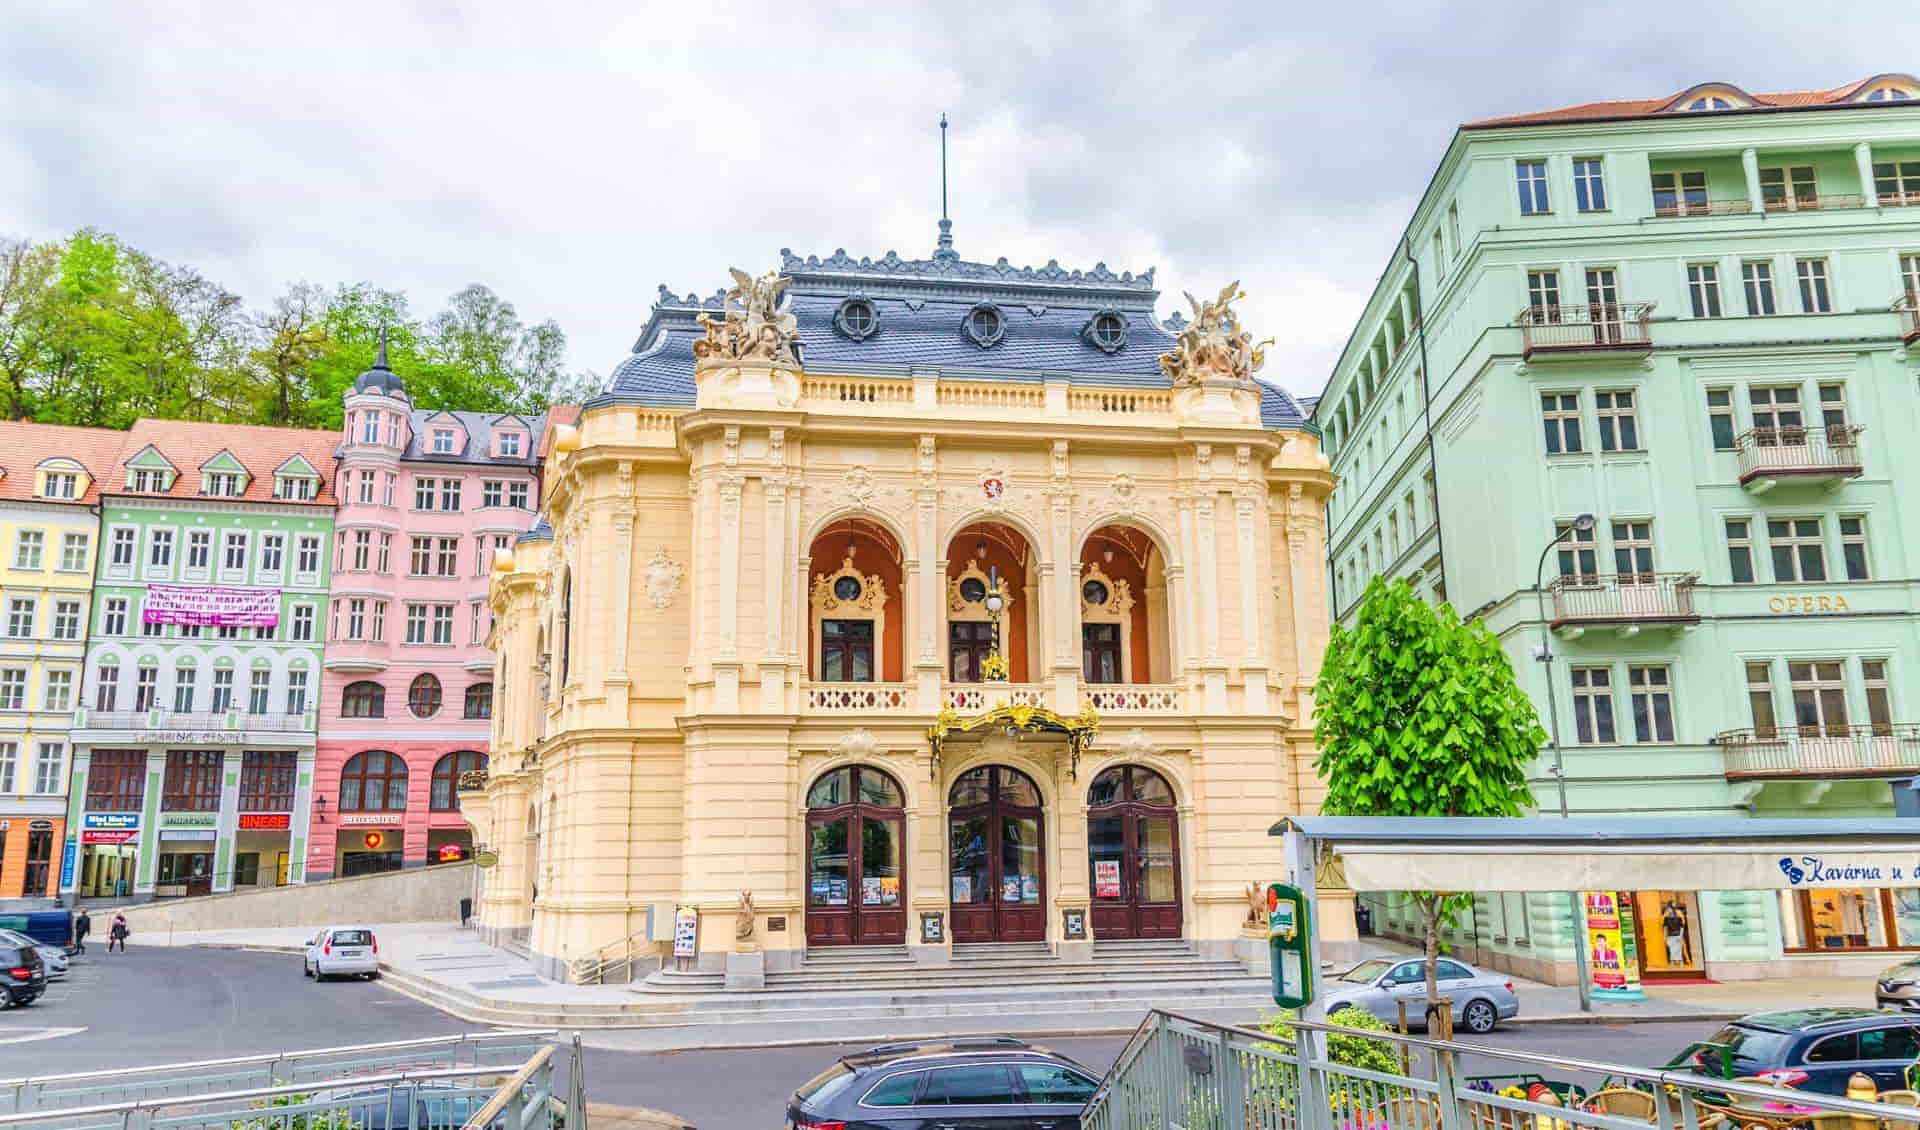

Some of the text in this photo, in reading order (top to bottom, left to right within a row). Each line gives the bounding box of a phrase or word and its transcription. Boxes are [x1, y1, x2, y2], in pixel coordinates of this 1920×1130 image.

[1768, 595, 1850, 613] OPERA
[1801, 856, 1881, 882] Kavárna
[1892, 866, 1903, 880] u
